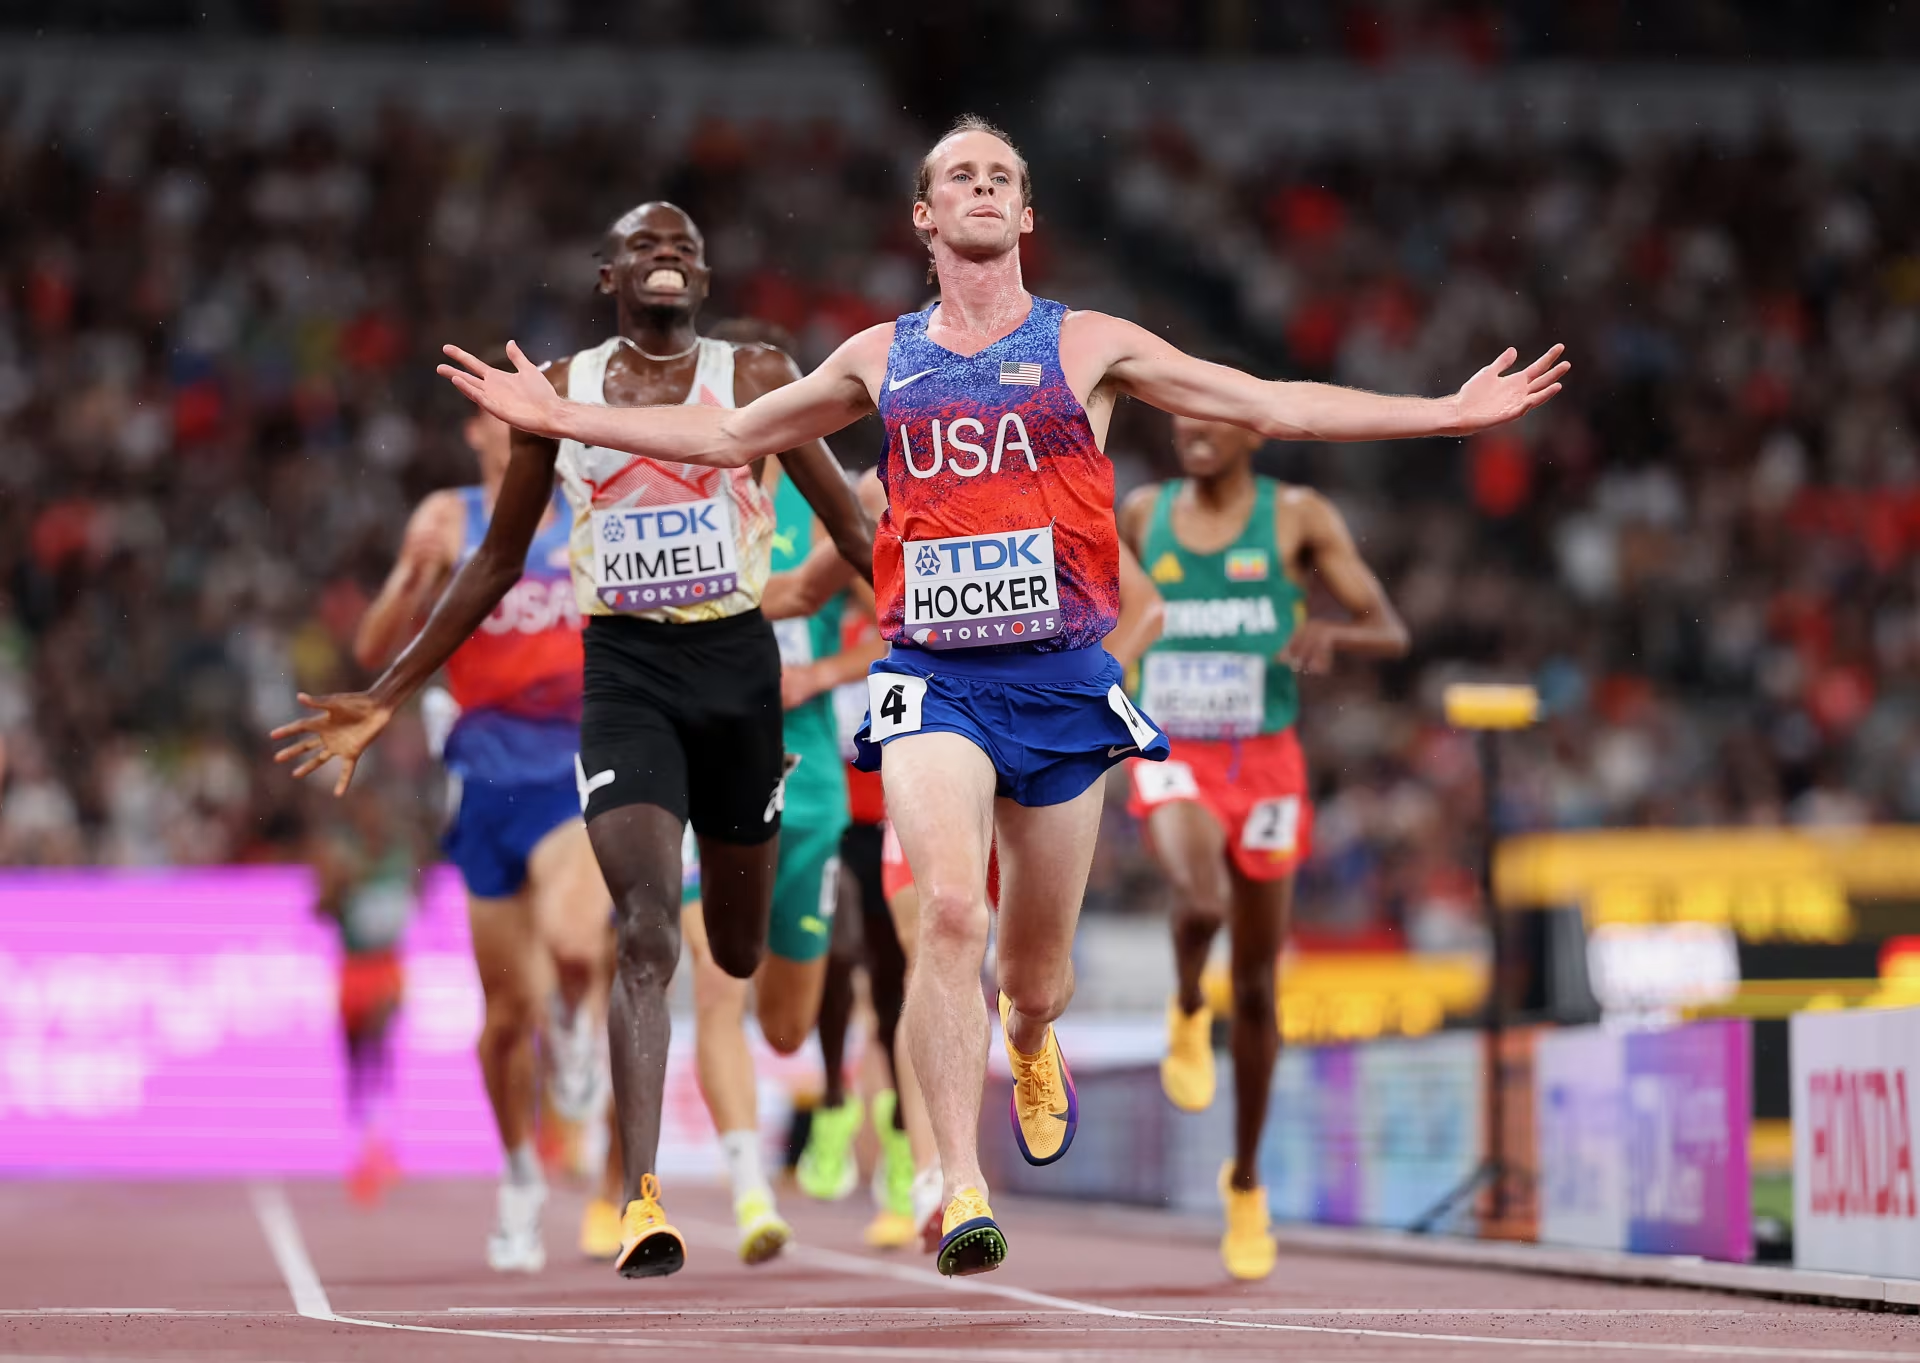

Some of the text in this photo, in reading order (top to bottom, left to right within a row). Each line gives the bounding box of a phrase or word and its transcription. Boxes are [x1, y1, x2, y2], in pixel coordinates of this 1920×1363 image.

[901, 412, 1038, 479] USA
[624, 504, 718, 540] TDK
[604, 541, 725, 582] KIMELI
[938, 533, 1043, 574] TDK
[479, 579, 582, 635] USA
[914, 575, 1050, 620] HOCKER
[880, 684, 907, 725] 4
[1261, 803, 1279, 837] 2
[1809, 1067, 1916, 1218] HONDA
